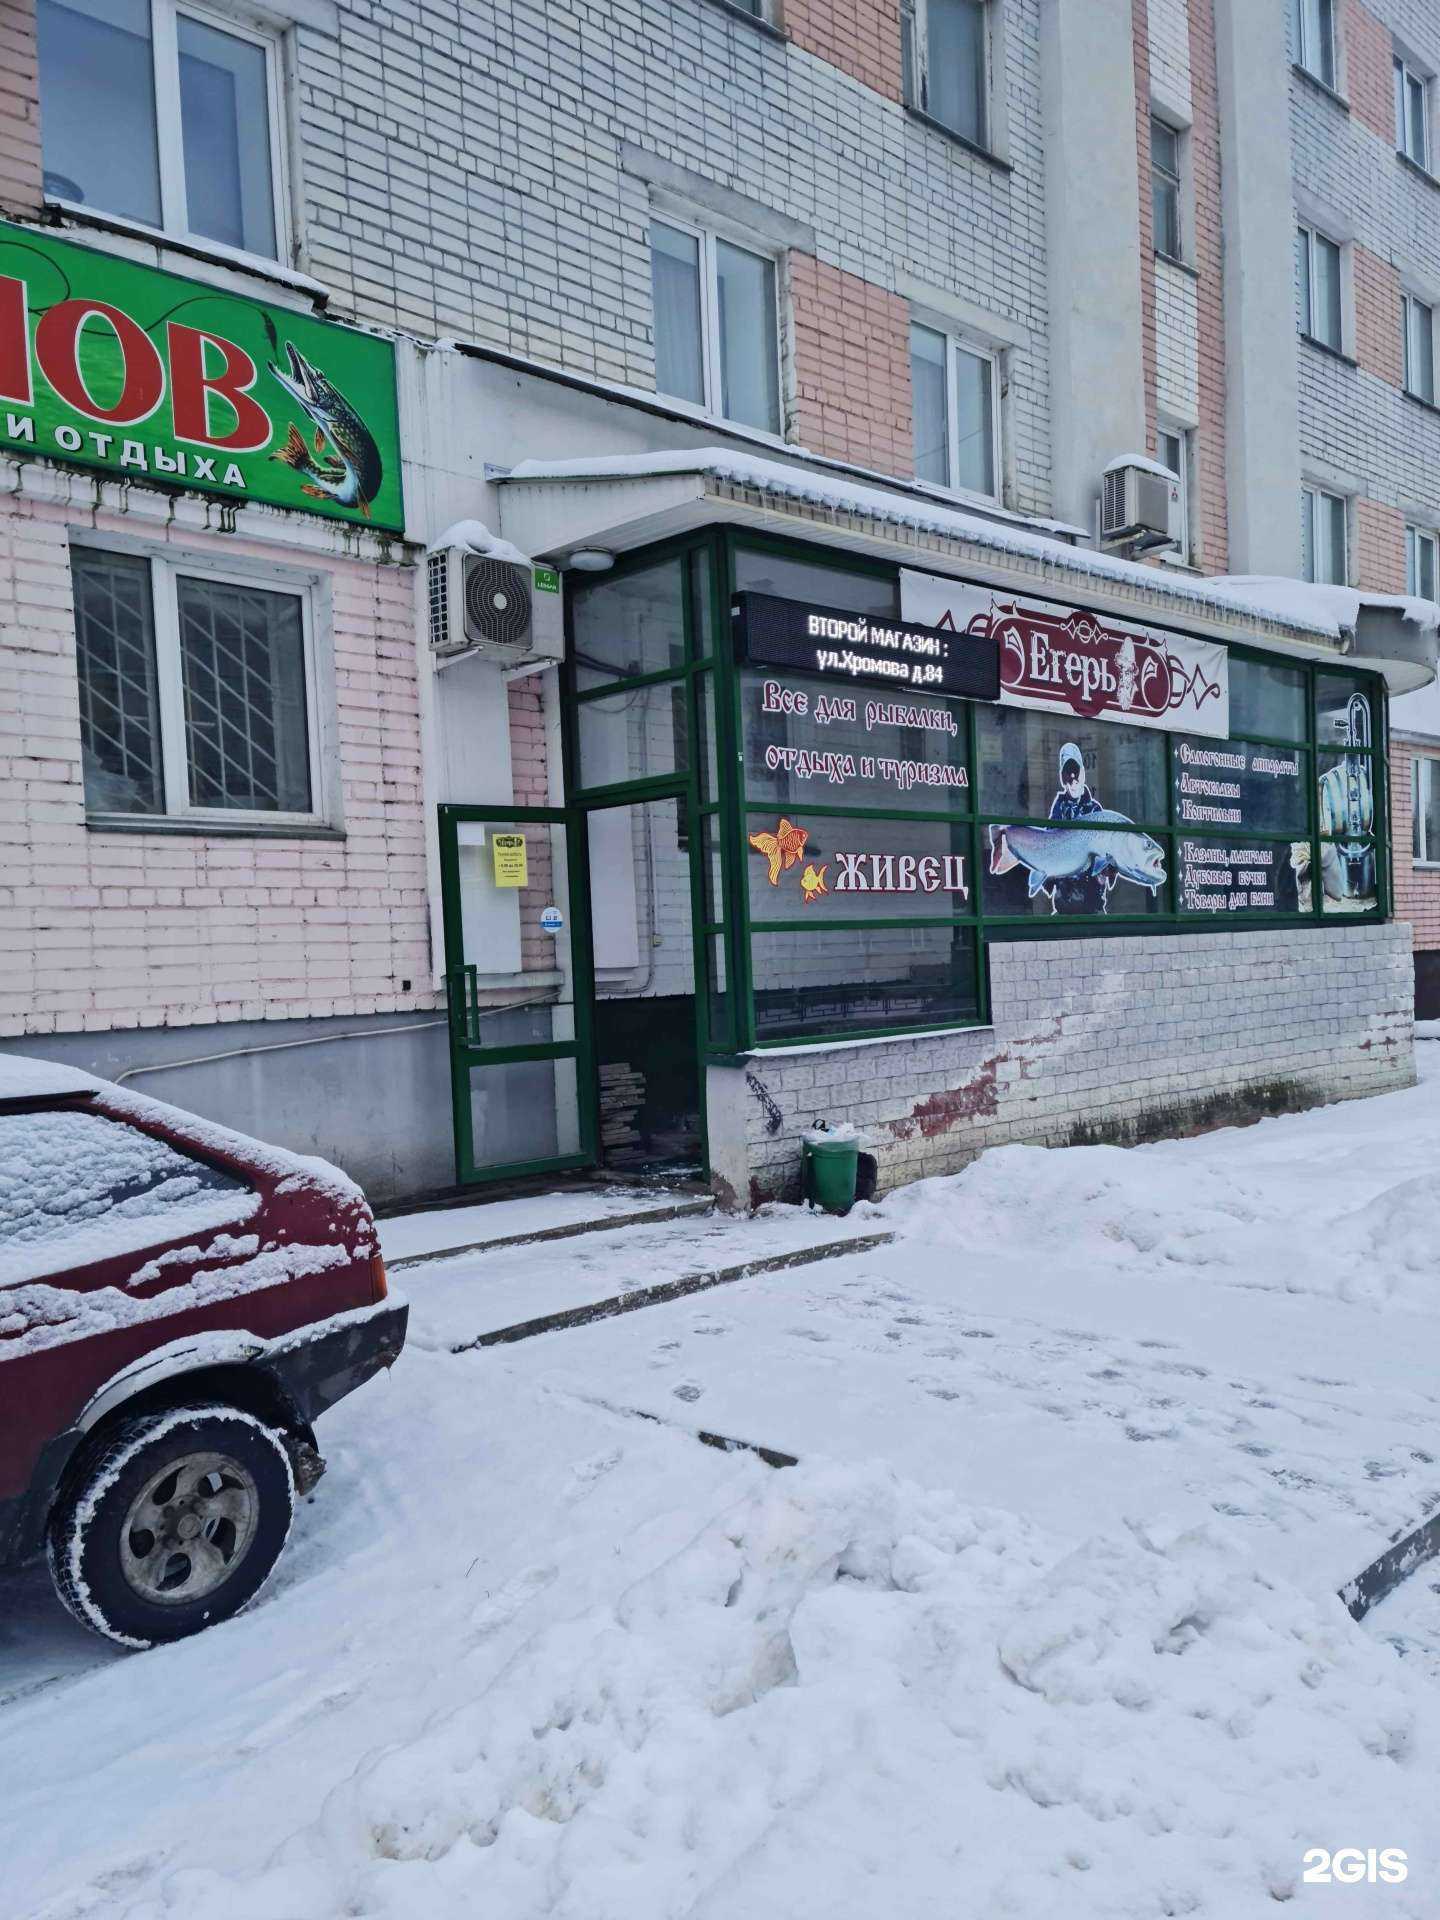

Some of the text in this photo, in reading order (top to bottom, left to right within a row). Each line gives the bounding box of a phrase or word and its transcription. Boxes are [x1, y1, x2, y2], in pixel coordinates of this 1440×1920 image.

[6, 412, 246, 489] И ОТДЫХА
[808, 615, 867, 642] ВТОРОЙ
[871, 628, 940, 656] МАГАЗИН
[816, 649, 943, 684] ул.Хромова д.84
[1029, 629, 1118, 701] Егерь
[762, 680, 958, 737] Все для рыбалки,
[766, 745, 969, 789] отдыха и туризма
[1180, 743, 1299, 778] Самогонные аппараты
[1180, 772, 1241, 798] Автоклавы
[1182, 799, 1242, 823] Коптильни
[834, 852, 969, 901] ЖИВЕЦ
[1184, 864, 1267, 889] Дубовые бочки
[1184, 889, 1275, 913] Товары для бани
